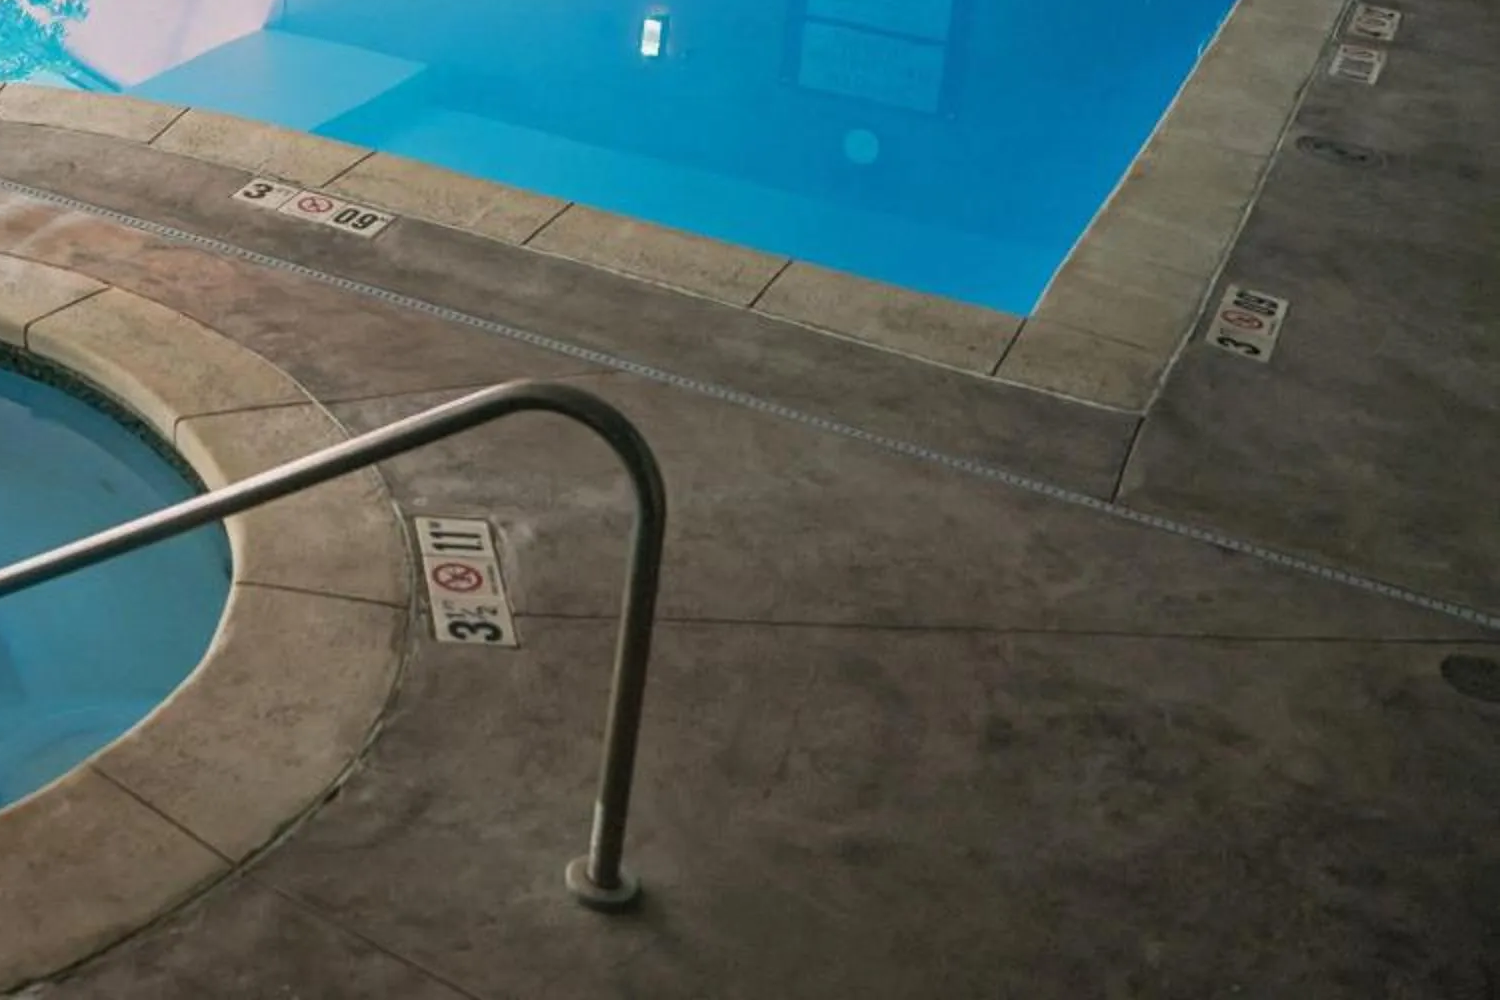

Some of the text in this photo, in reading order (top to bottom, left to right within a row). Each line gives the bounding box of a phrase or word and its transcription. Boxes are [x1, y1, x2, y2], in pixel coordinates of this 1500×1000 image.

[243, 183, 380, 230] 3 09
[1216, 337, 1261, 355] 3
